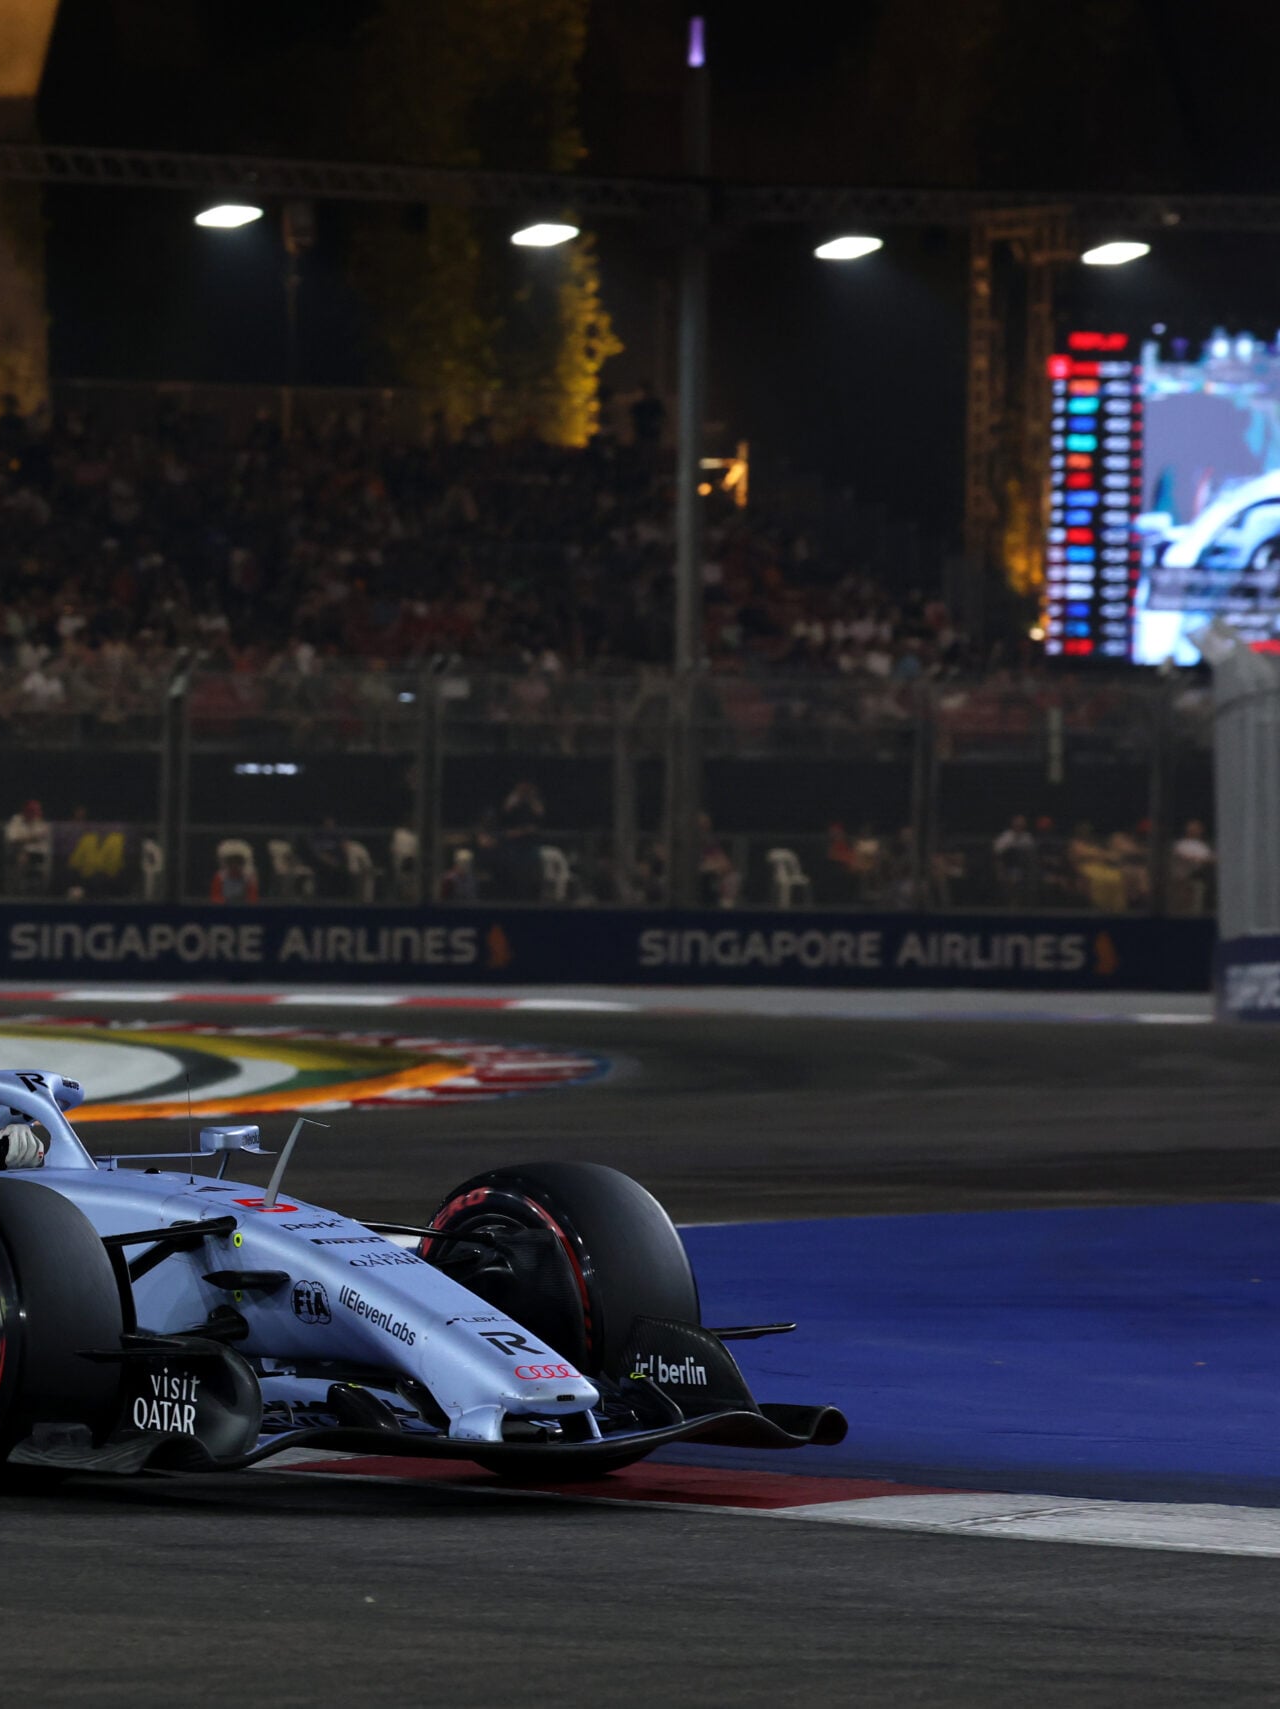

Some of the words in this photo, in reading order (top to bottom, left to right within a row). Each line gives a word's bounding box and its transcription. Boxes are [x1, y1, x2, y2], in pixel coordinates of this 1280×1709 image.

[9, 922, 264, 961] SINGAPORE
[279, 925, 477, 964] AIRLINES
[638, 929, 881, 967] SINGAPORE
[897, 932, 1085, 970] AIRLINES
[349, 1258, 424, 1268] QATAR
[150, 1367, 200, 1402] visit
[658, 1355, 708, 1386] berlin
[133, 1397, 196, 1435] QATAR
